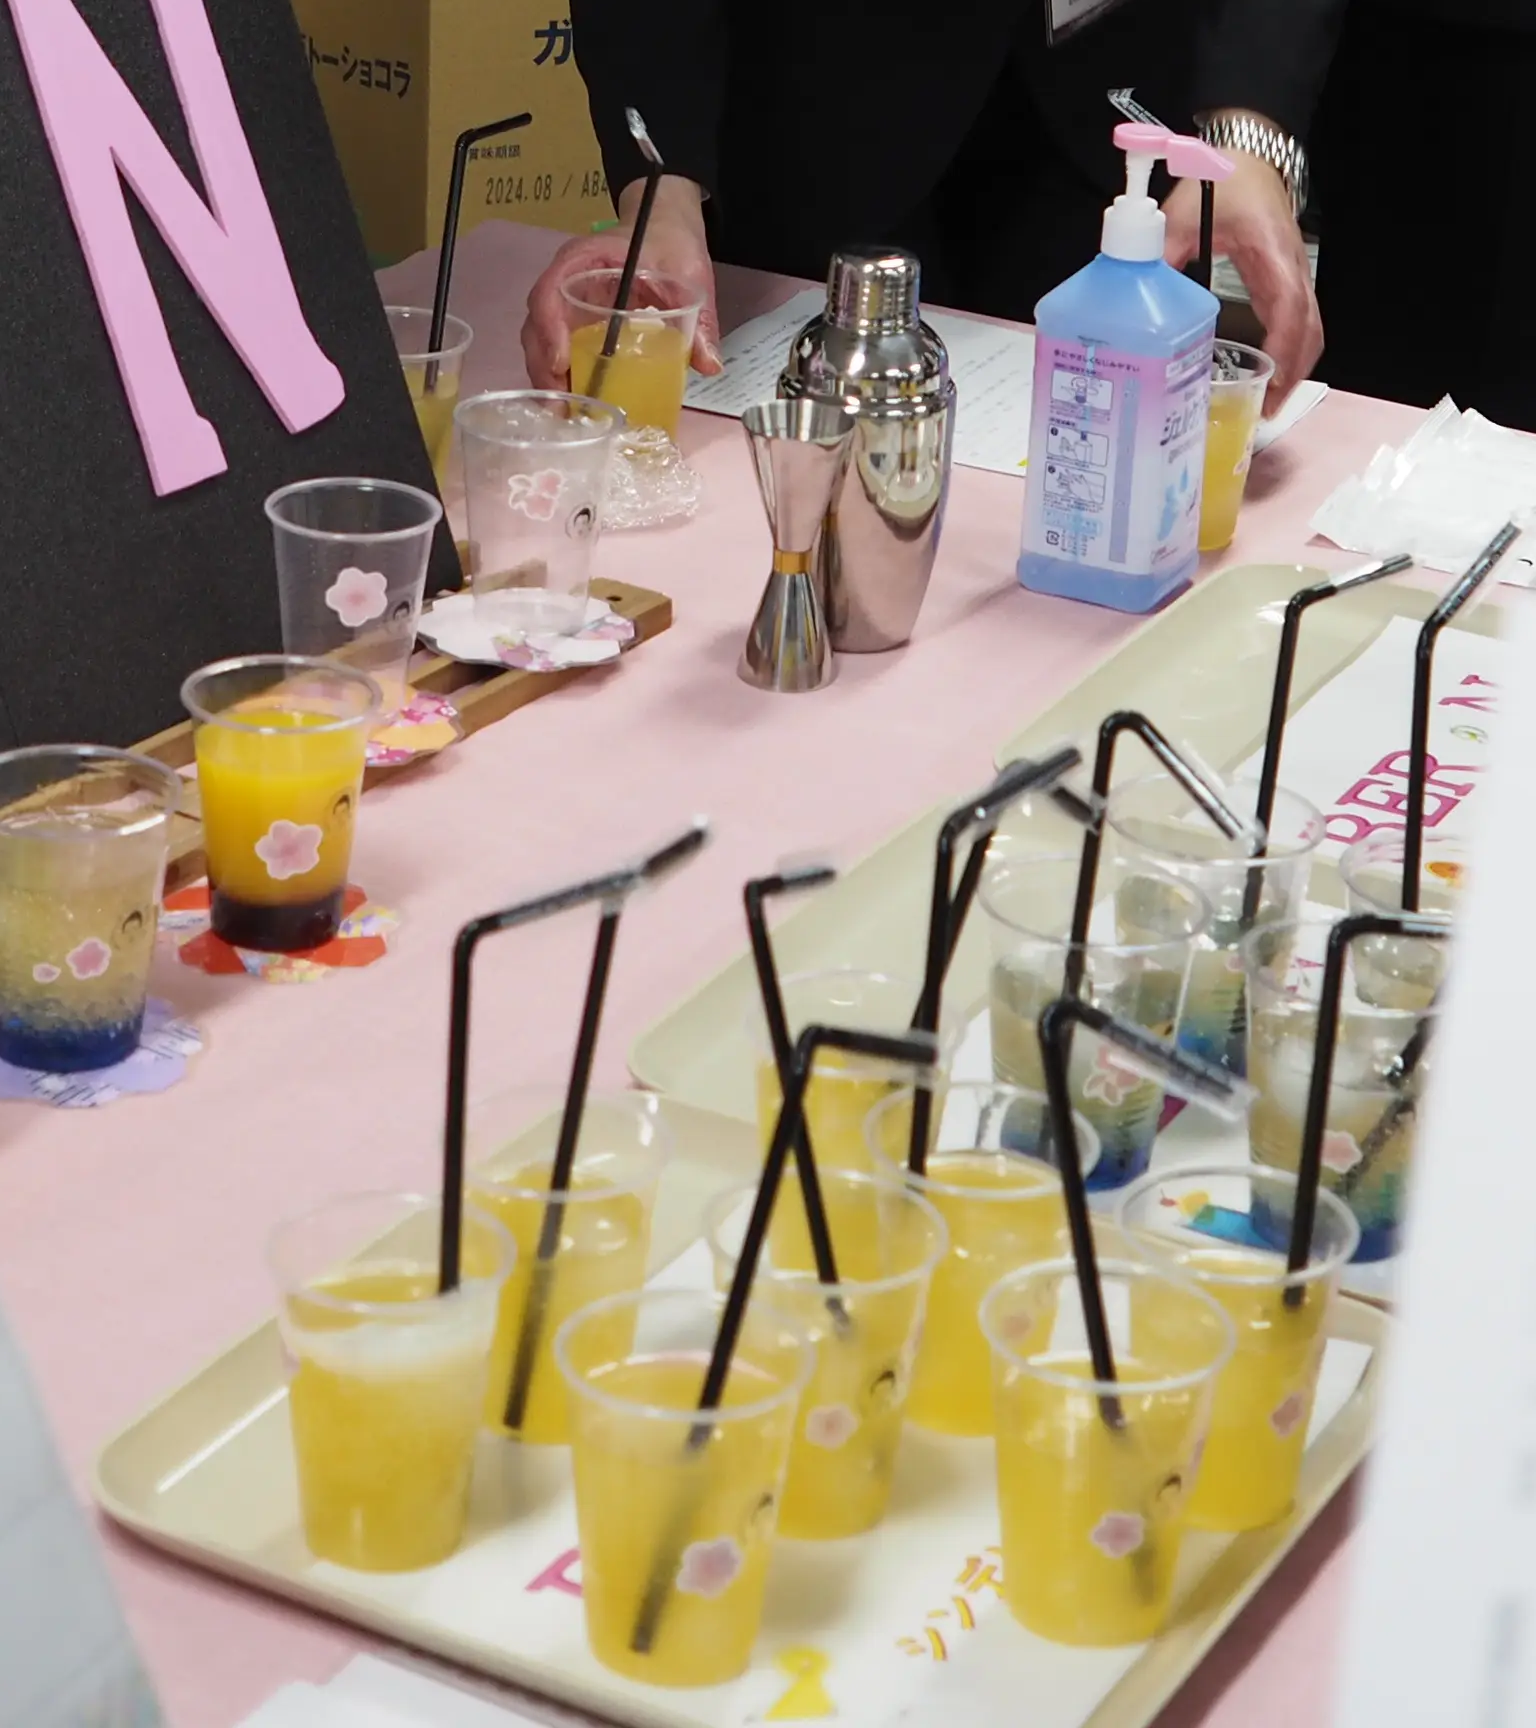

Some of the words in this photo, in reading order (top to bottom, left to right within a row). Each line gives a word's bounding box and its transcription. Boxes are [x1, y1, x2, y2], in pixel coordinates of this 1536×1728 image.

[298, 32, 411, 100] トーショコラ
[485, 176, 552, 206] 2024.08
